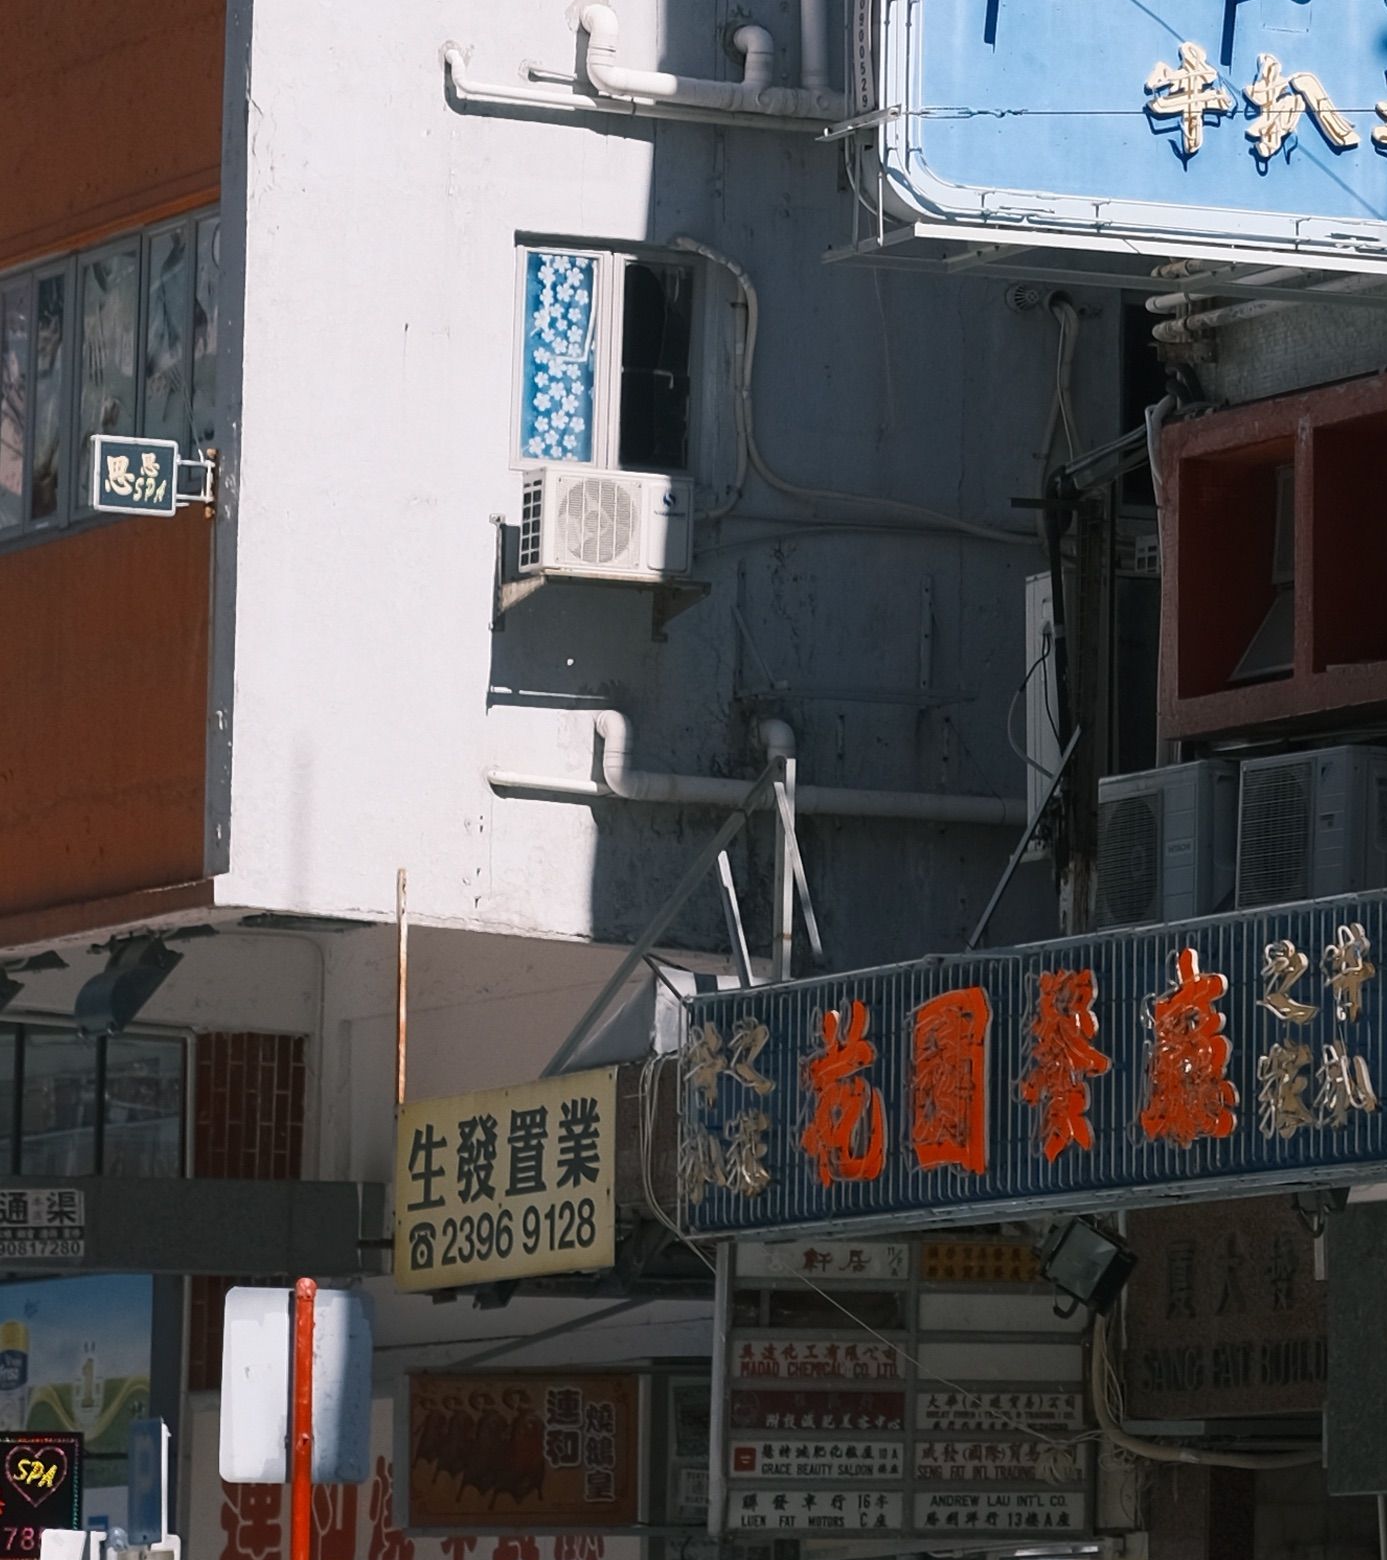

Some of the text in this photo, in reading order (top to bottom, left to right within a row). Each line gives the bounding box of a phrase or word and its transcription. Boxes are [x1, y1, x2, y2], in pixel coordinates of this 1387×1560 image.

[406, 1097, 602, 1212] 生發置業
[442, 1199, 596, 1265] 2396 9128
[544, 1386, 582, 1468] 連和
[12, 1458, 59, 1489] SPA
[930, 1495, 980, 1507] ANDREW
[987, 1495, 1010, 1507] LAU
